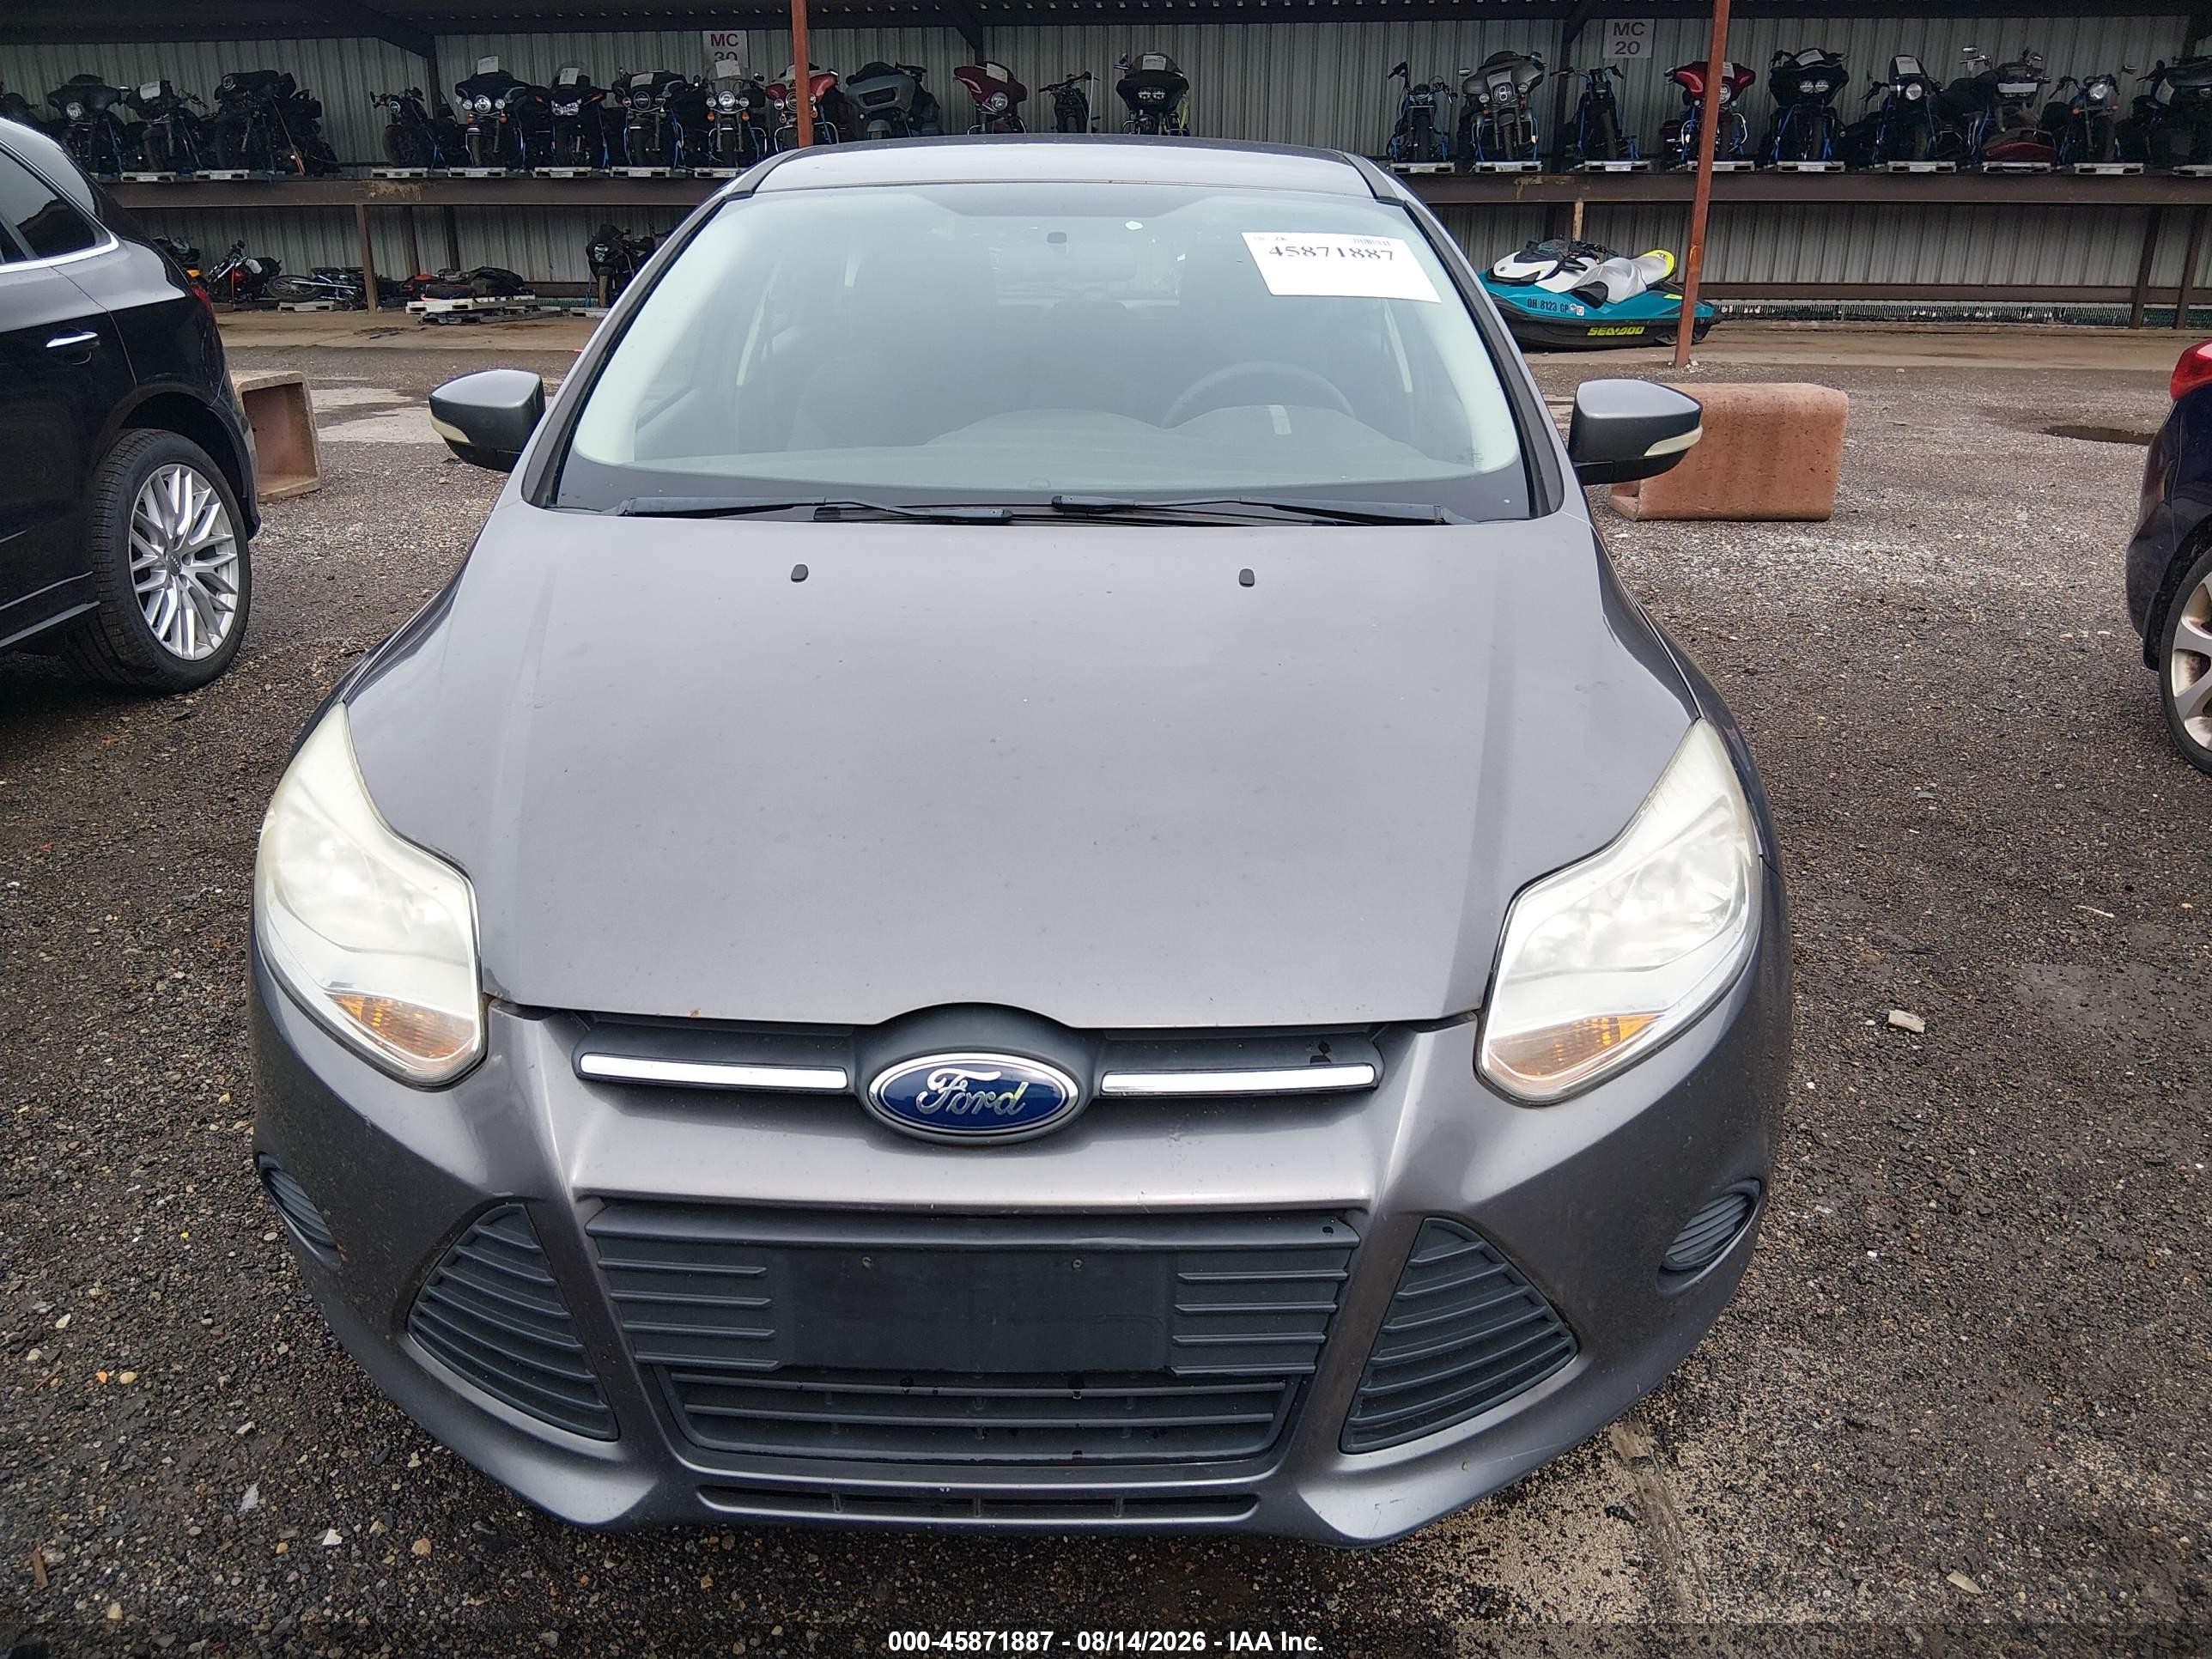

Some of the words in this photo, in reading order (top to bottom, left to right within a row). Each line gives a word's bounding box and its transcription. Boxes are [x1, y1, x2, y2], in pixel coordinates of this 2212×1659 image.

[1613, 22, 1645, 36] MC
[710, 33, 738, 47] MC
[1614, 40, 1641, 55] 20
[1268, 246, 1394, 261] 45871887
[1527, 298, 1538, 309] OH
[1540, 300, 1557, 312] 8123
[1559, 303, 1569, 313] GP
[915, 1067, 1028, 1115] Ford
